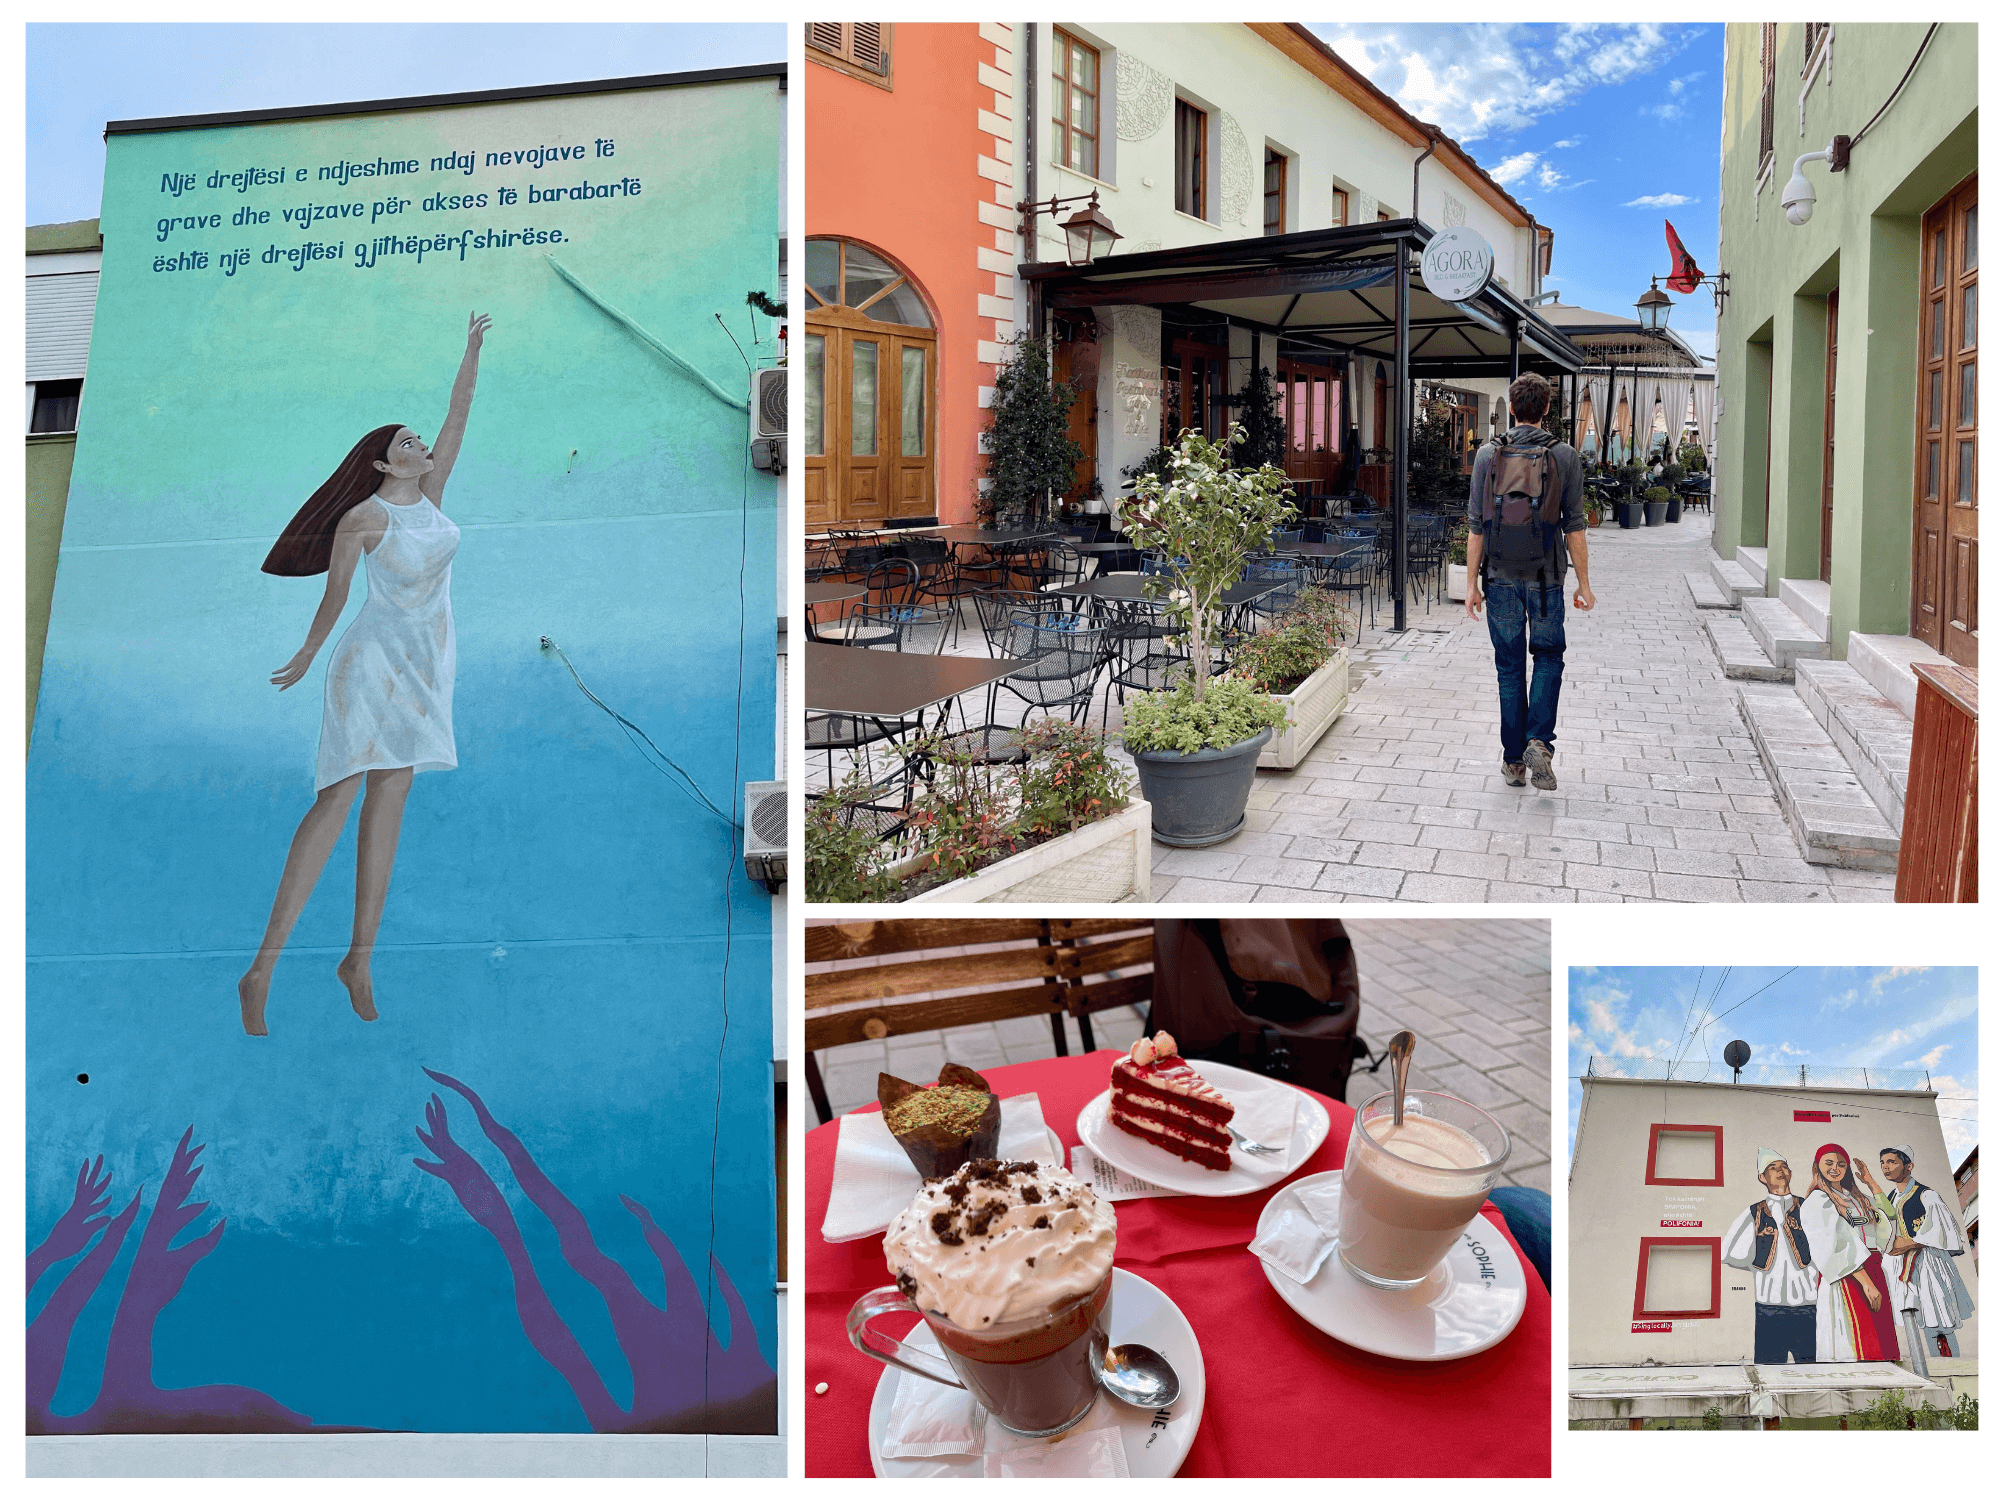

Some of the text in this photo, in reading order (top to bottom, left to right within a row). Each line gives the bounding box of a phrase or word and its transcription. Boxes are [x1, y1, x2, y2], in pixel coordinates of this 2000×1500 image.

[160, 138, 615, 198] Një drejtësi e ndjeshme ndaj nevojave të
[156, 177, 642, 242] grave dhe vajzave për akses të barabartë
[152, 228, 570, 276] është një drejtësi gjithëpërfshirëse.
[1428, 250, 1484, 272] AGORA
[1467, 1241, 1496, 1280] SOPHIE
